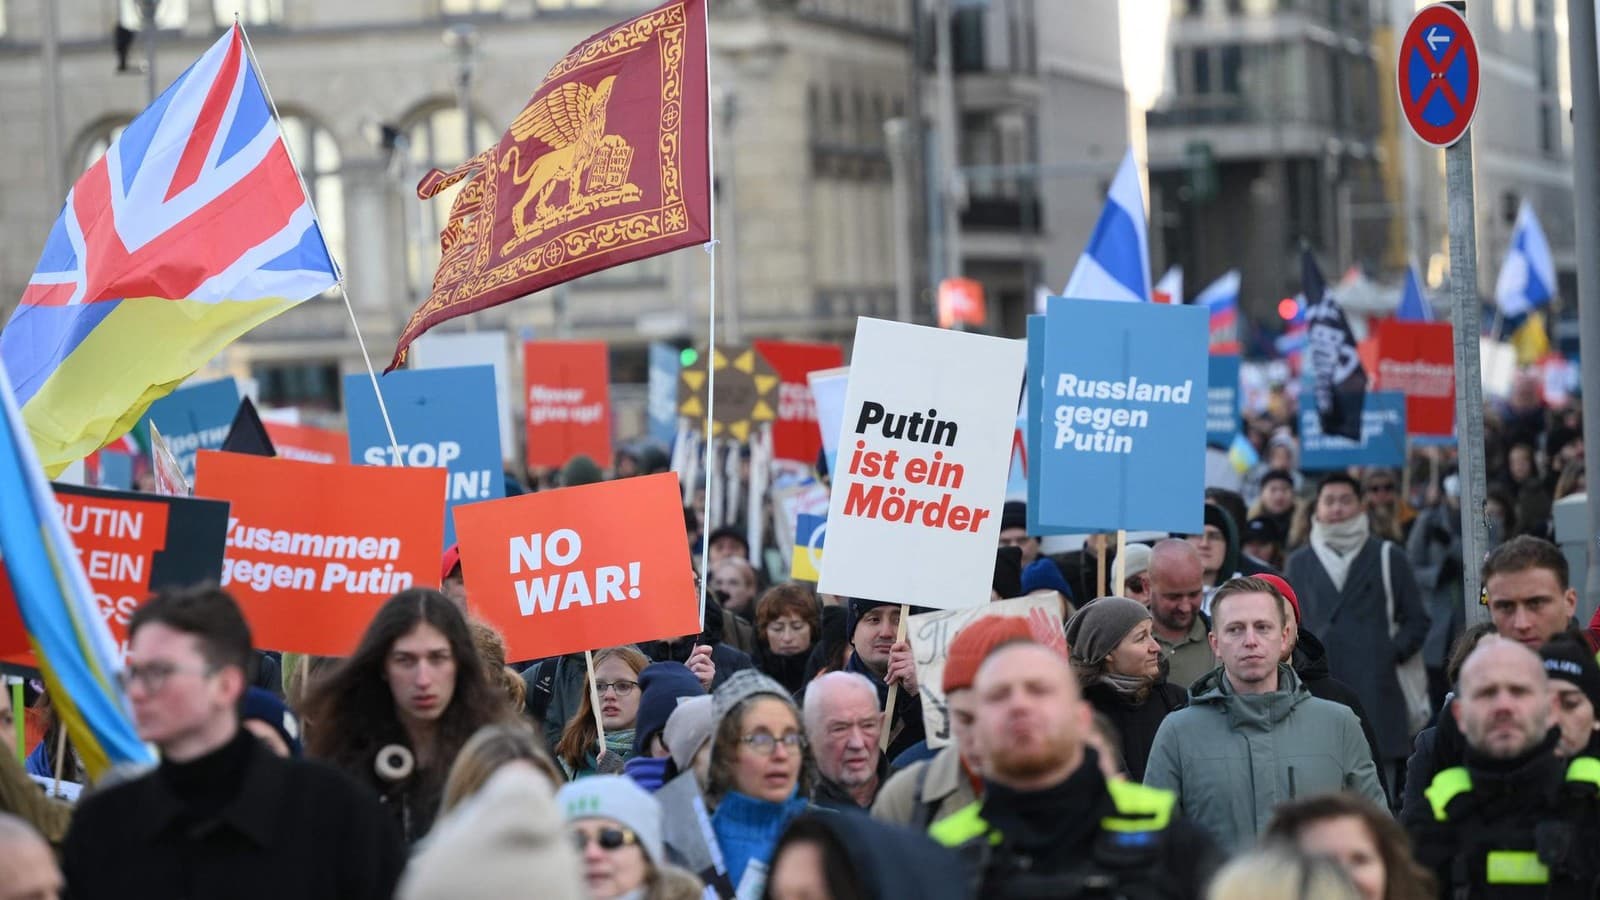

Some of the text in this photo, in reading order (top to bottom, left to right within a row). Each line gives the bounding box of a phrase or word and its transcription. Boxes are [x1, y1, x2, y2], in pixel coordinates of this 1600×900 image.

[1056, 373, 1193, 404] Russland
[855, 401, 958, 447] Putin
[1054, 405, 1148, 430] gegen
[364, 441, 461, 468] STOP
[1055, 426, 1133, 454] Putin
[848, 440, 964, 489] ist ein
[843, 482, 990, 533] Mörder
[88, 550, 144, 583] EIN
[510, 528, 582, 574] NO
[321, 562, 413, 595] Putin
[514, 561, 641, 616] WAR!
